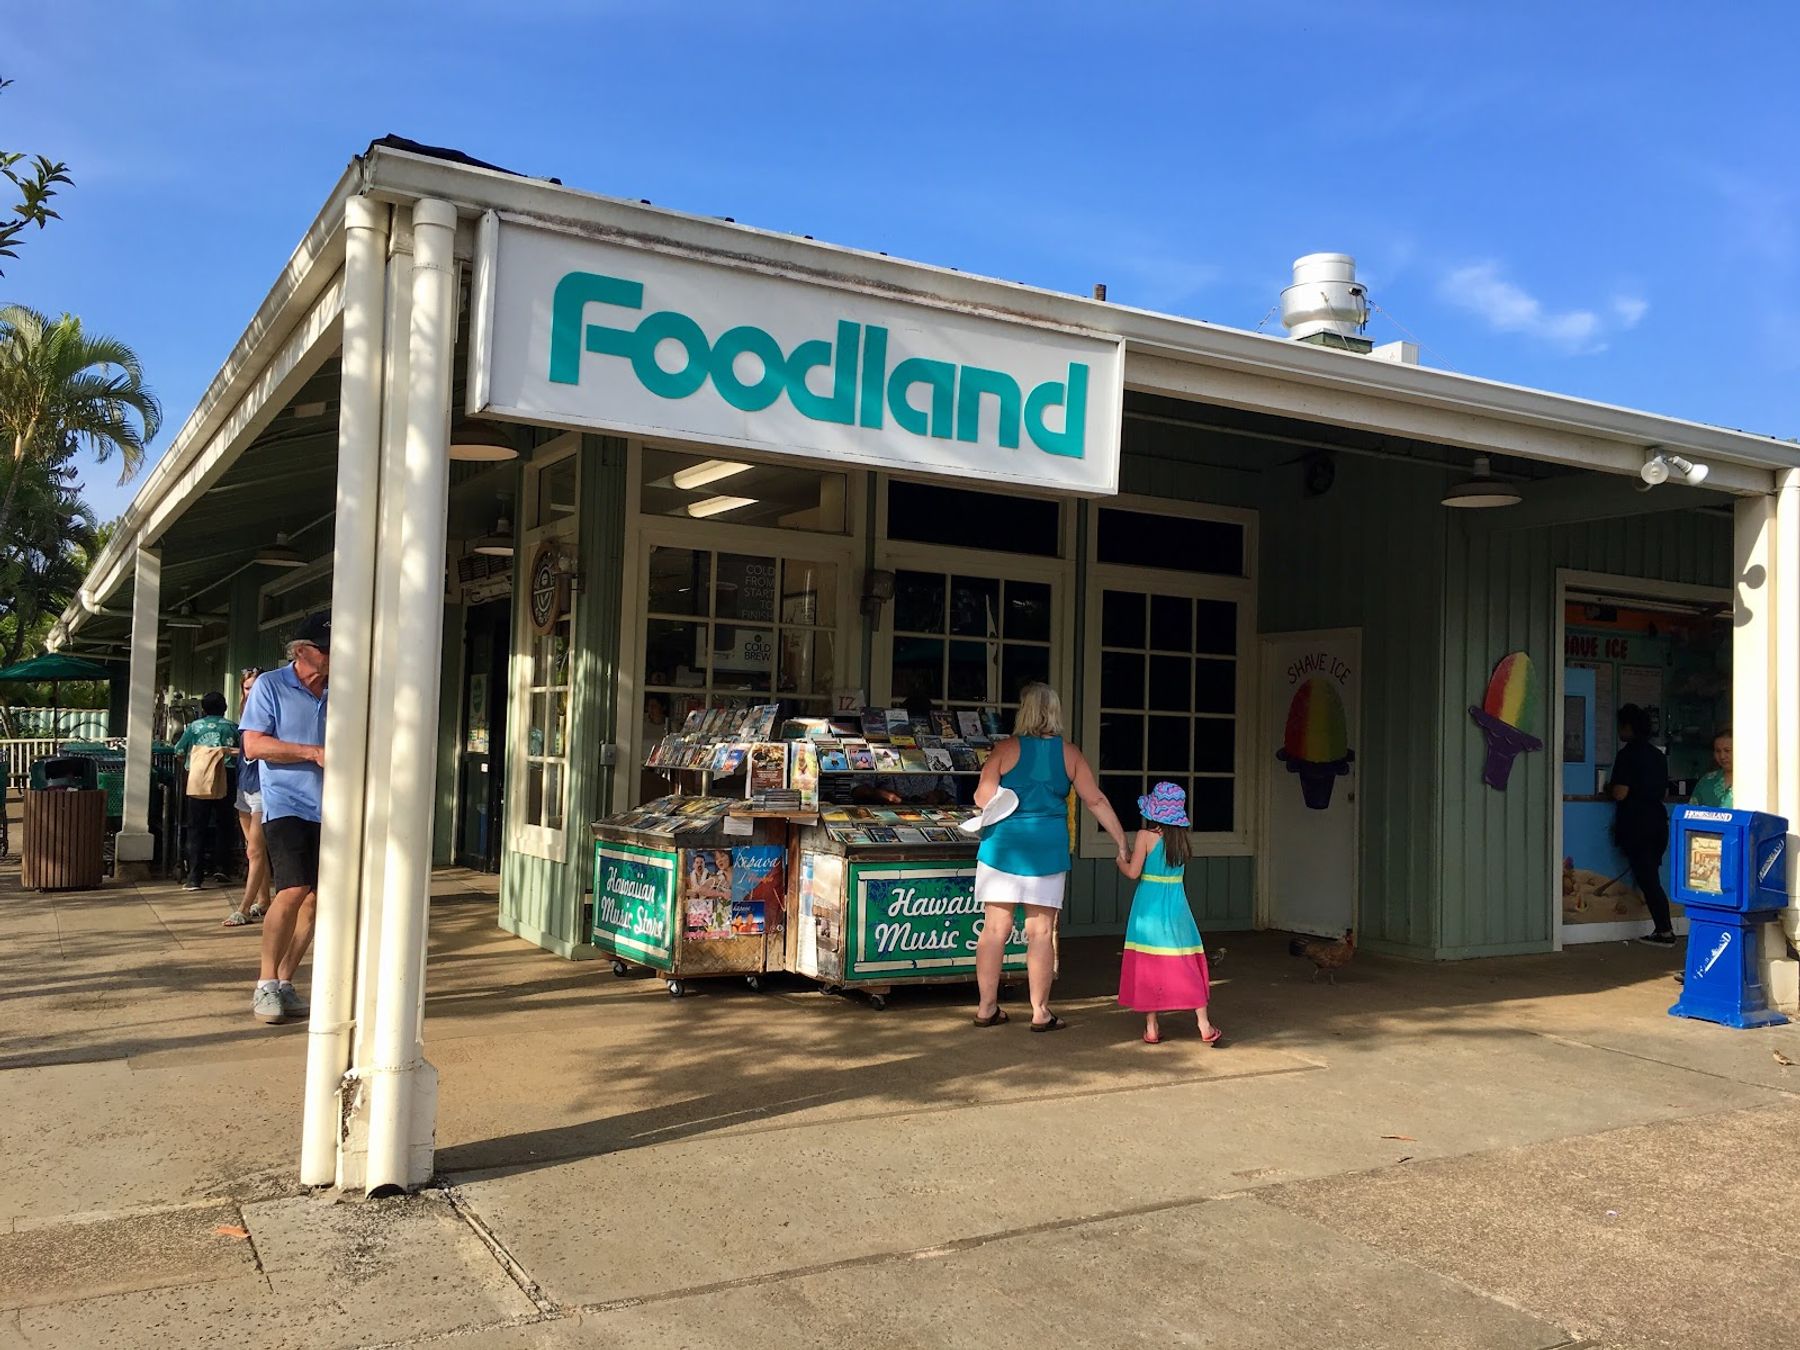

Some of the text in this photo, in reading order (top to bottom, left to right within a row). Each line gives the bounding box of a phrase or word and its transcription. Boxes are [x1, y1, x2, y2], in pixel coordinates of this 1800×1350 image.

[548, 271, 1090, 459] Foodland
[746, 564, 775, 577] COLD
[743, 587, 776, 599] START
[744, 642, 772, 653] COLD
[744, 652, 772, 662] BREW
[1606, 638, 1628, 658] ICE
[1287, 653, 1352, 685] SHAVE ICE
[606, 866, 656, 903] Hawaiian
[601, 895, 664, 939] Music Store
[875, 919, 1029, 952] Music Sre
